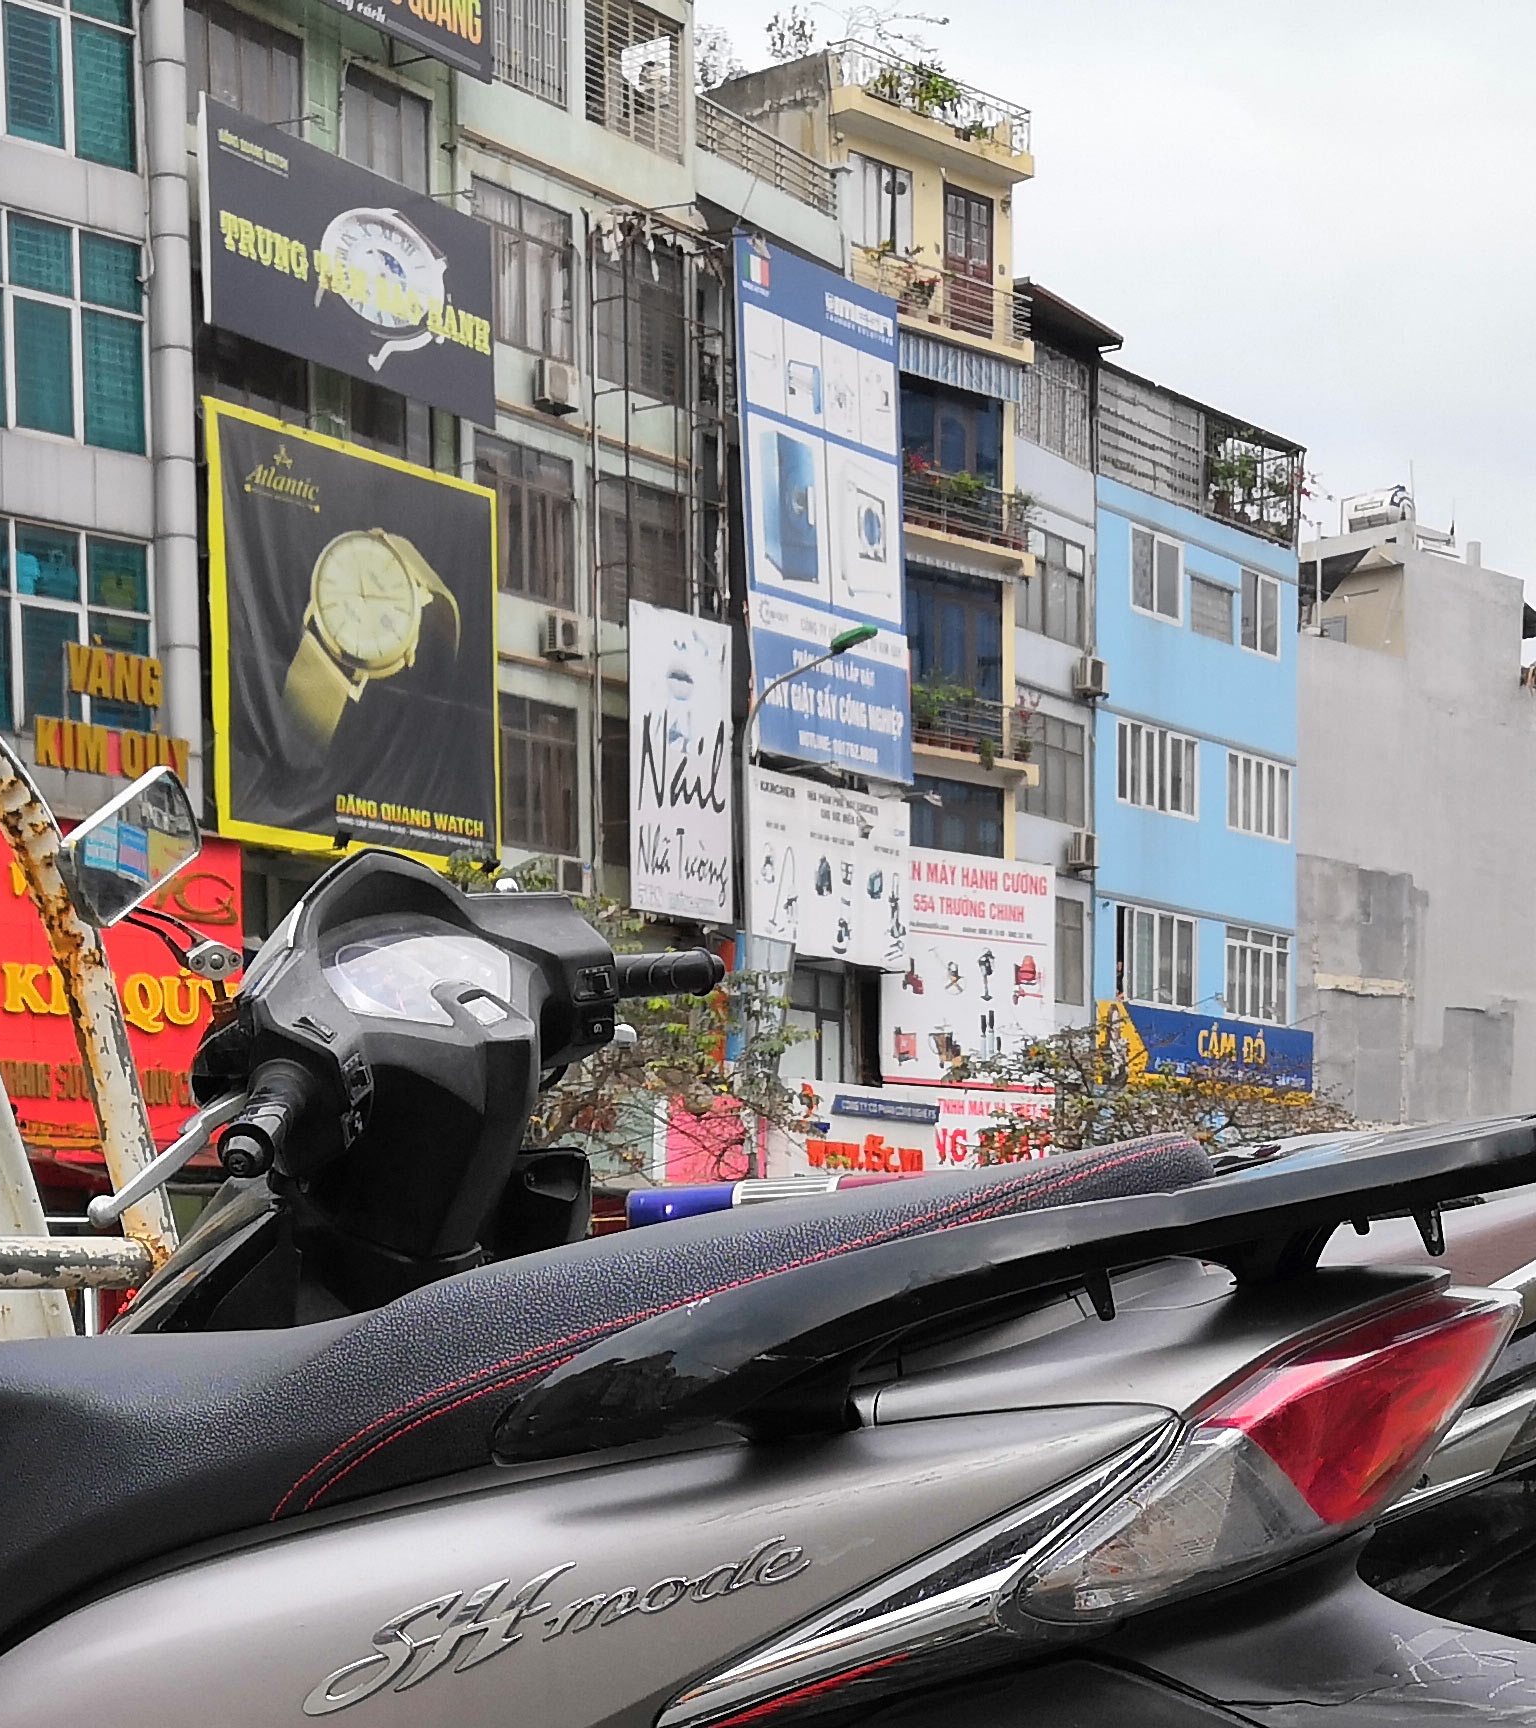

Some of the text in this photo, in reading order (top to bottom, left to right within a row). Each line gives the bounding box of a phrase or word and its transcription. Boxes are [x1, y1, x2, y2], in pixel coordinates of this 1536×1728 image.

[219, 210, 309, 282] TRUNG
[66, 634, 164, 708] VÀNG
[35, 714, 109, 775] KIM
[637, 709, 726, 814] Nail
[434, 812, 484, 838] WATCH
[927, 859, 956, 885] MÁY
[990, 903, 1024, 923] CHINH
[1, 962, 71, 1016] KI
[542, 1534, 812, 1642] mode
